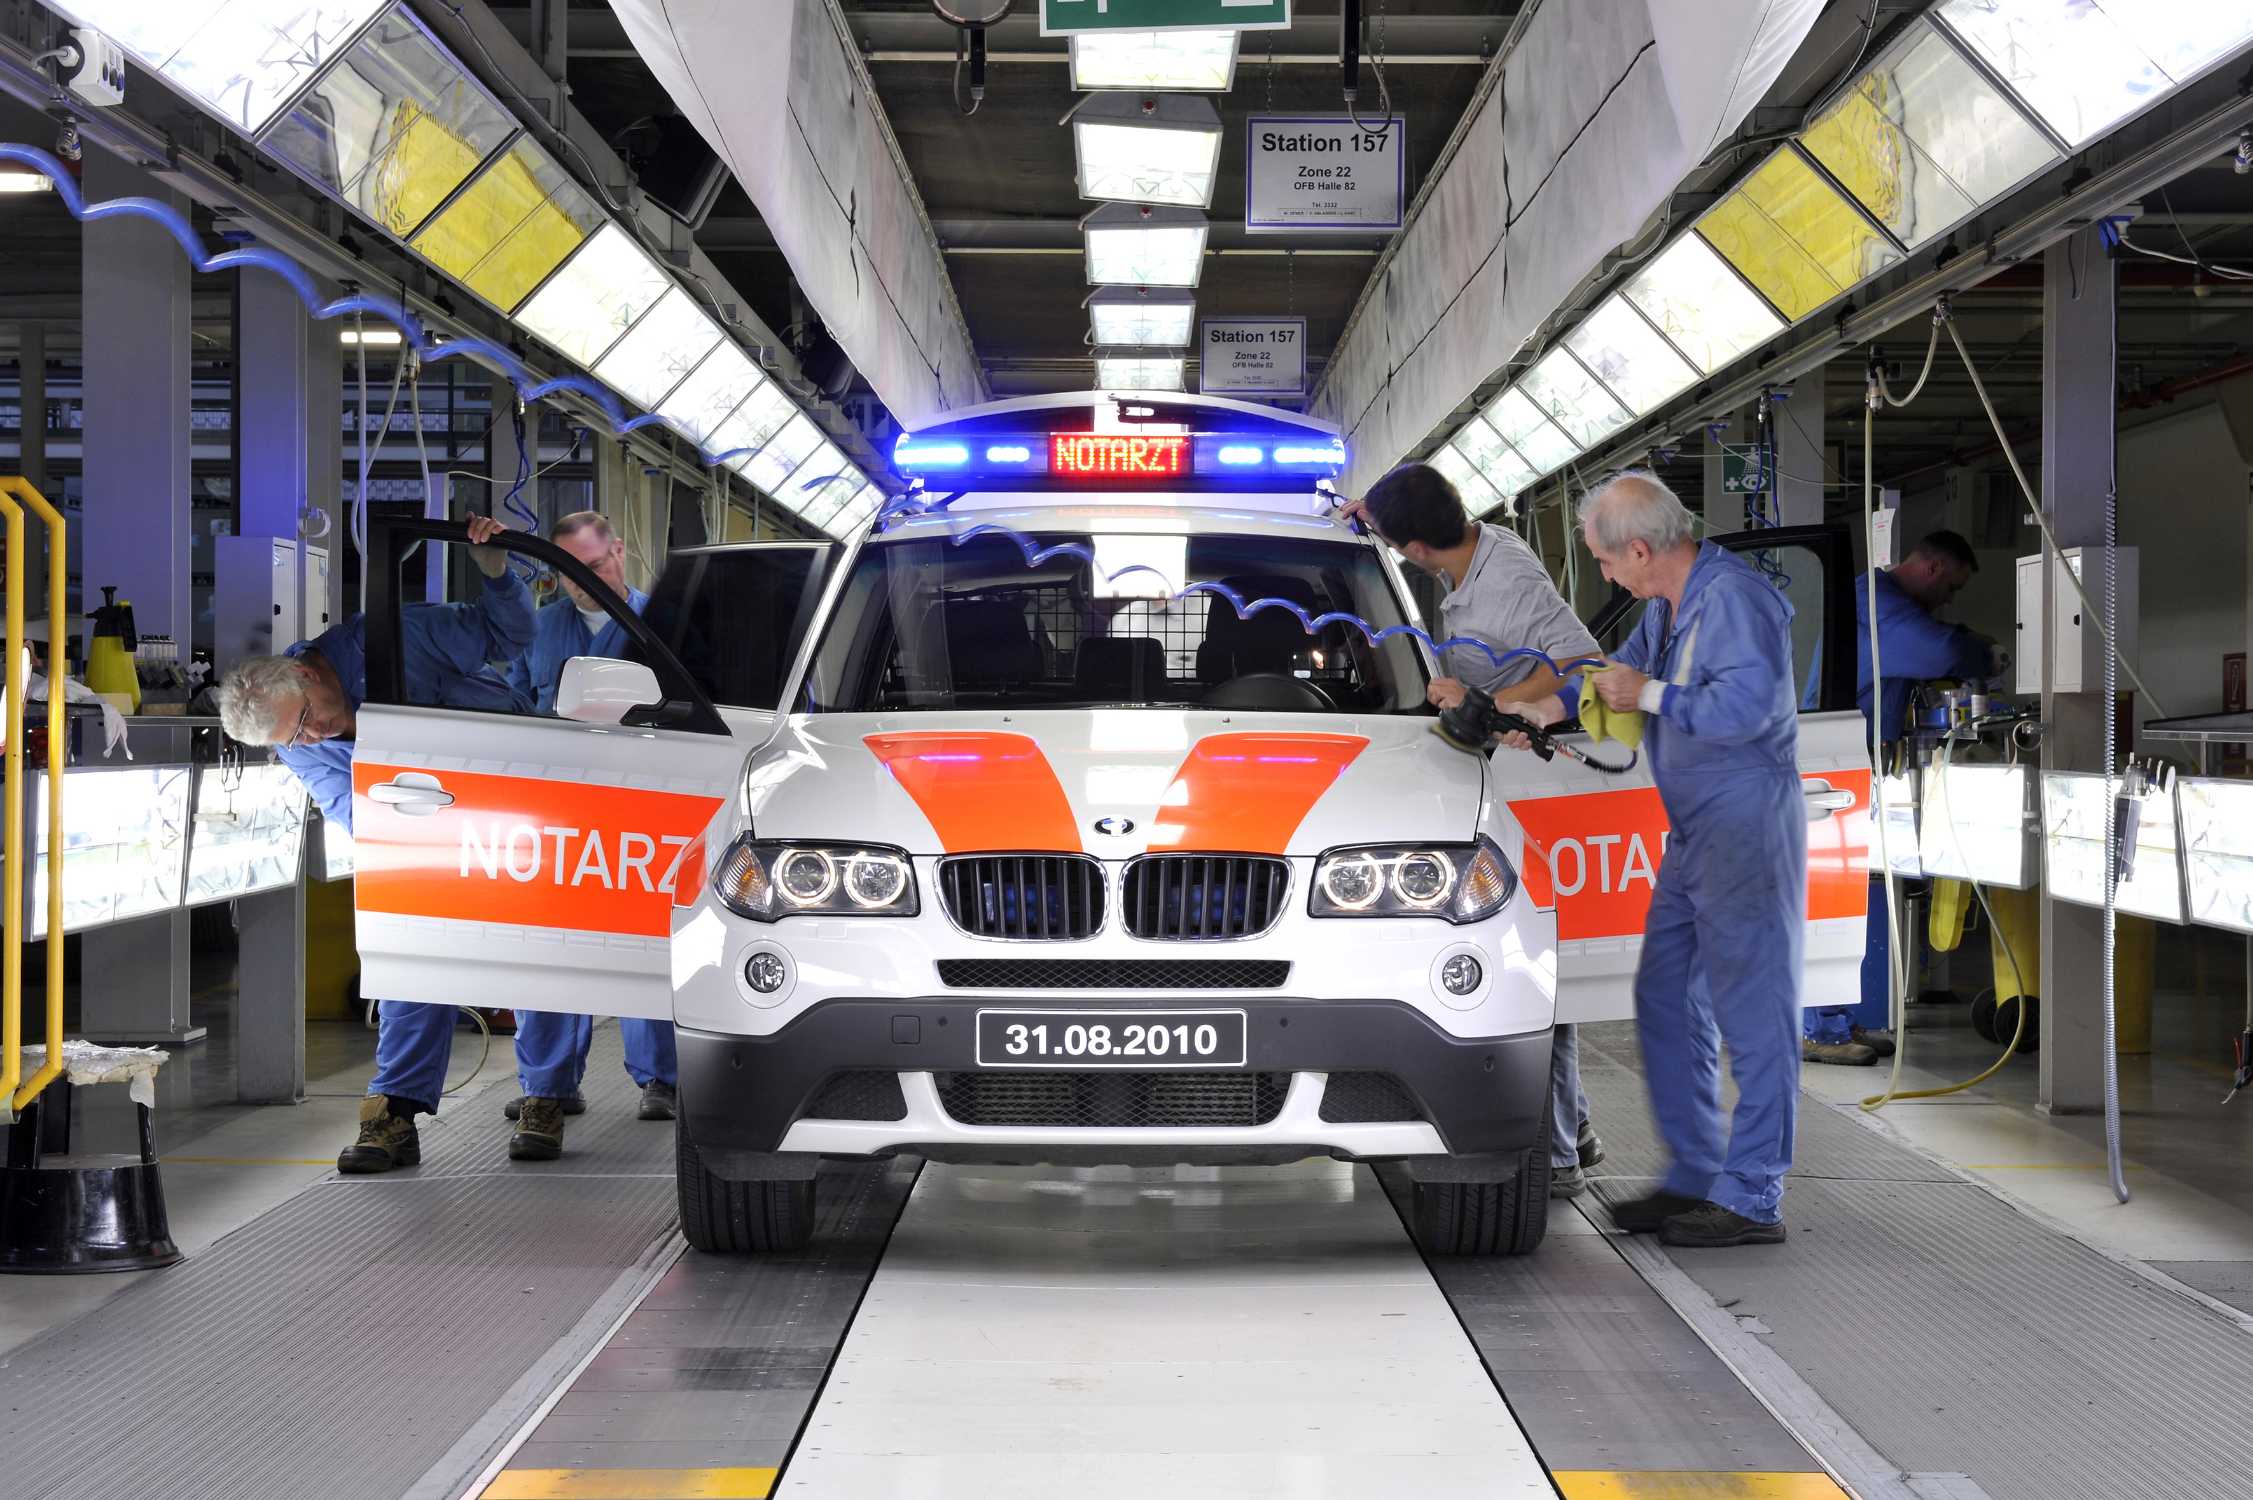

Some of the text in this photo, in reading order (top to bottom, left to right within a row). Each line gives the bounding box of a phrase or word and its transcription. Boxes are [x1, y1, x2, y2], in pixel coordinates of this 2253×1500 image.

[1262, 133, 1389, 152] Station 157
[1298, 166, 1351, 177] Zone 22
[1294, 181, 1356, 191] OFB Halle 82
[1210, 329, 1296, 343] Station 157
[1235, 351, 1271, 360] Zone 22
[1248, 361, 1264, 369] Halle
[1056, 437, 1184, 471] NOTARZT
[459, 818, 694, 895] NOTARZ
[1549, 831, 1670, 897] OTA
[1004, 1024, 1218, 1056] 31.08.2010
